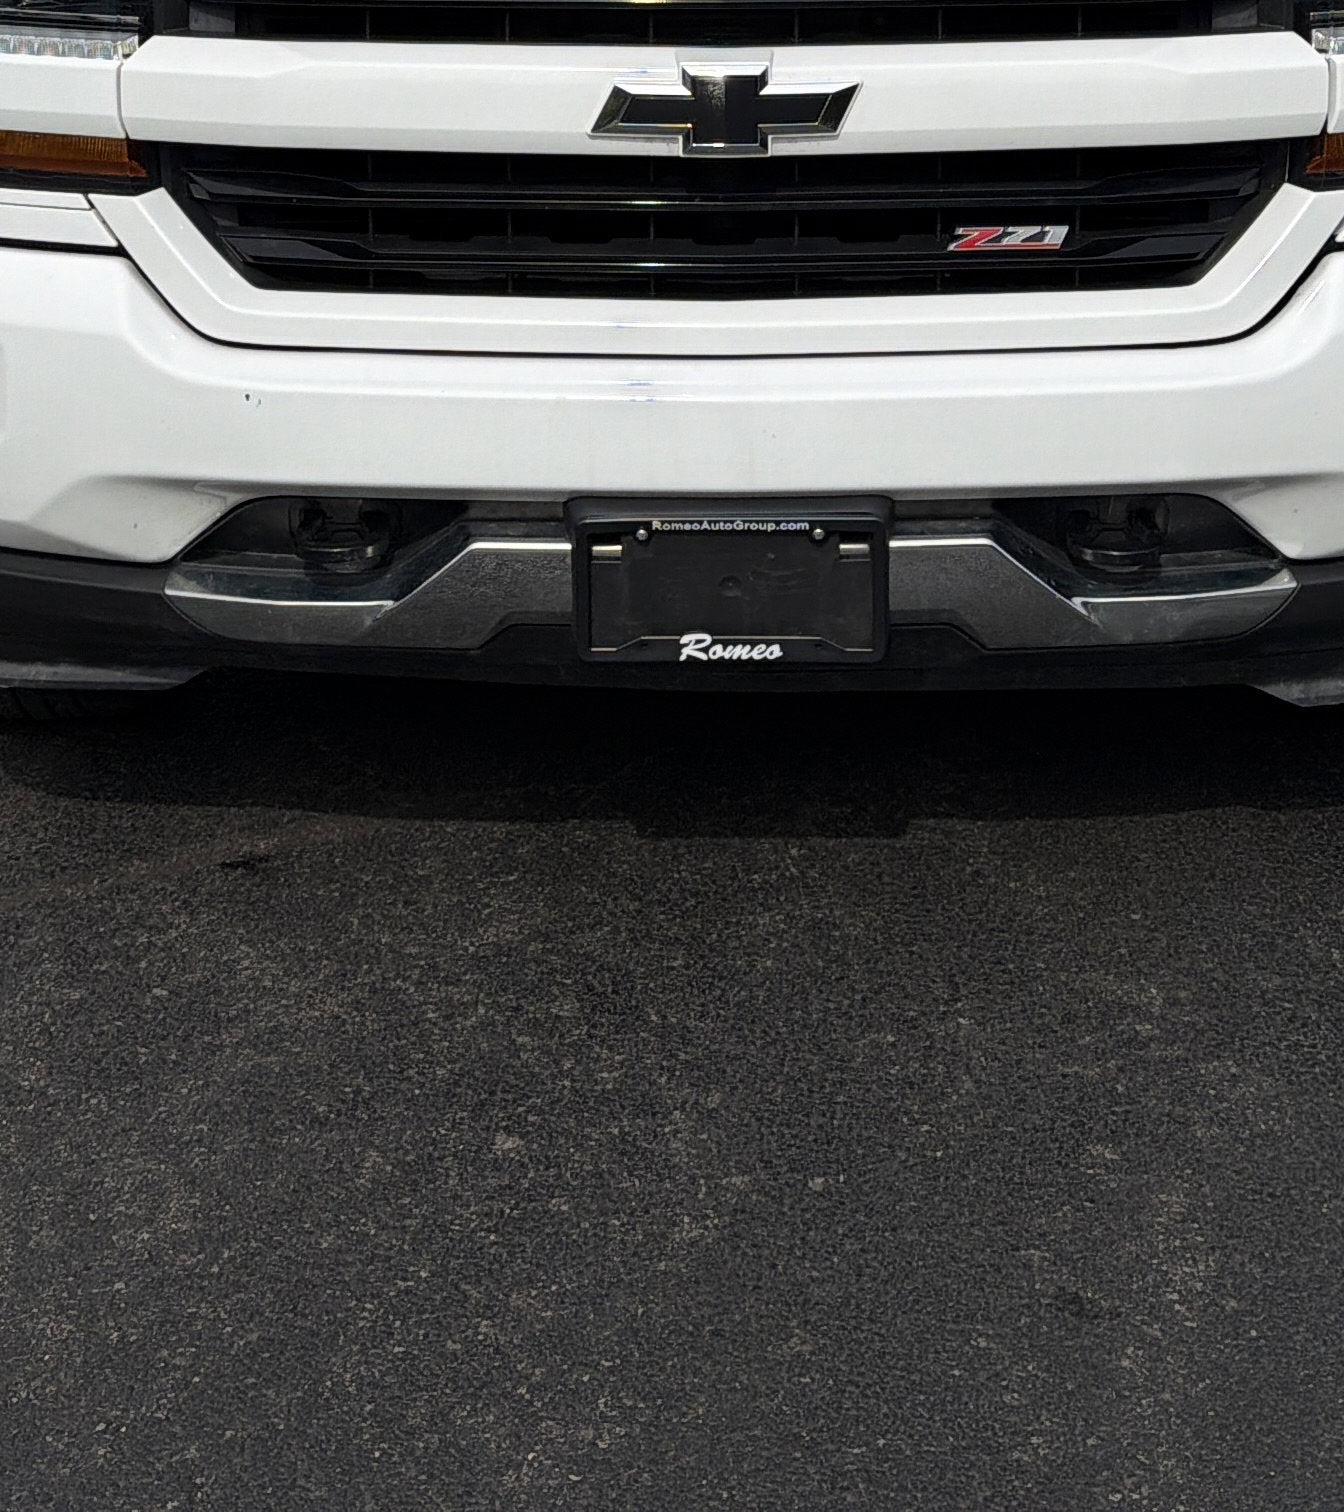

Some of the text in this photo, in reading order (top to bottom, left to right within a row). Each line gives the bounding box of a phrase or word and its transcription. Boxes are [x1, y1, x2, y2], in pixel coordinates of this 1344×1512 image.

[947, 225, 1069, 251] Z71
[651, 520, 810, 533] RomeoAutoGroup.com
[679, 633, 784, 661] Romeo
